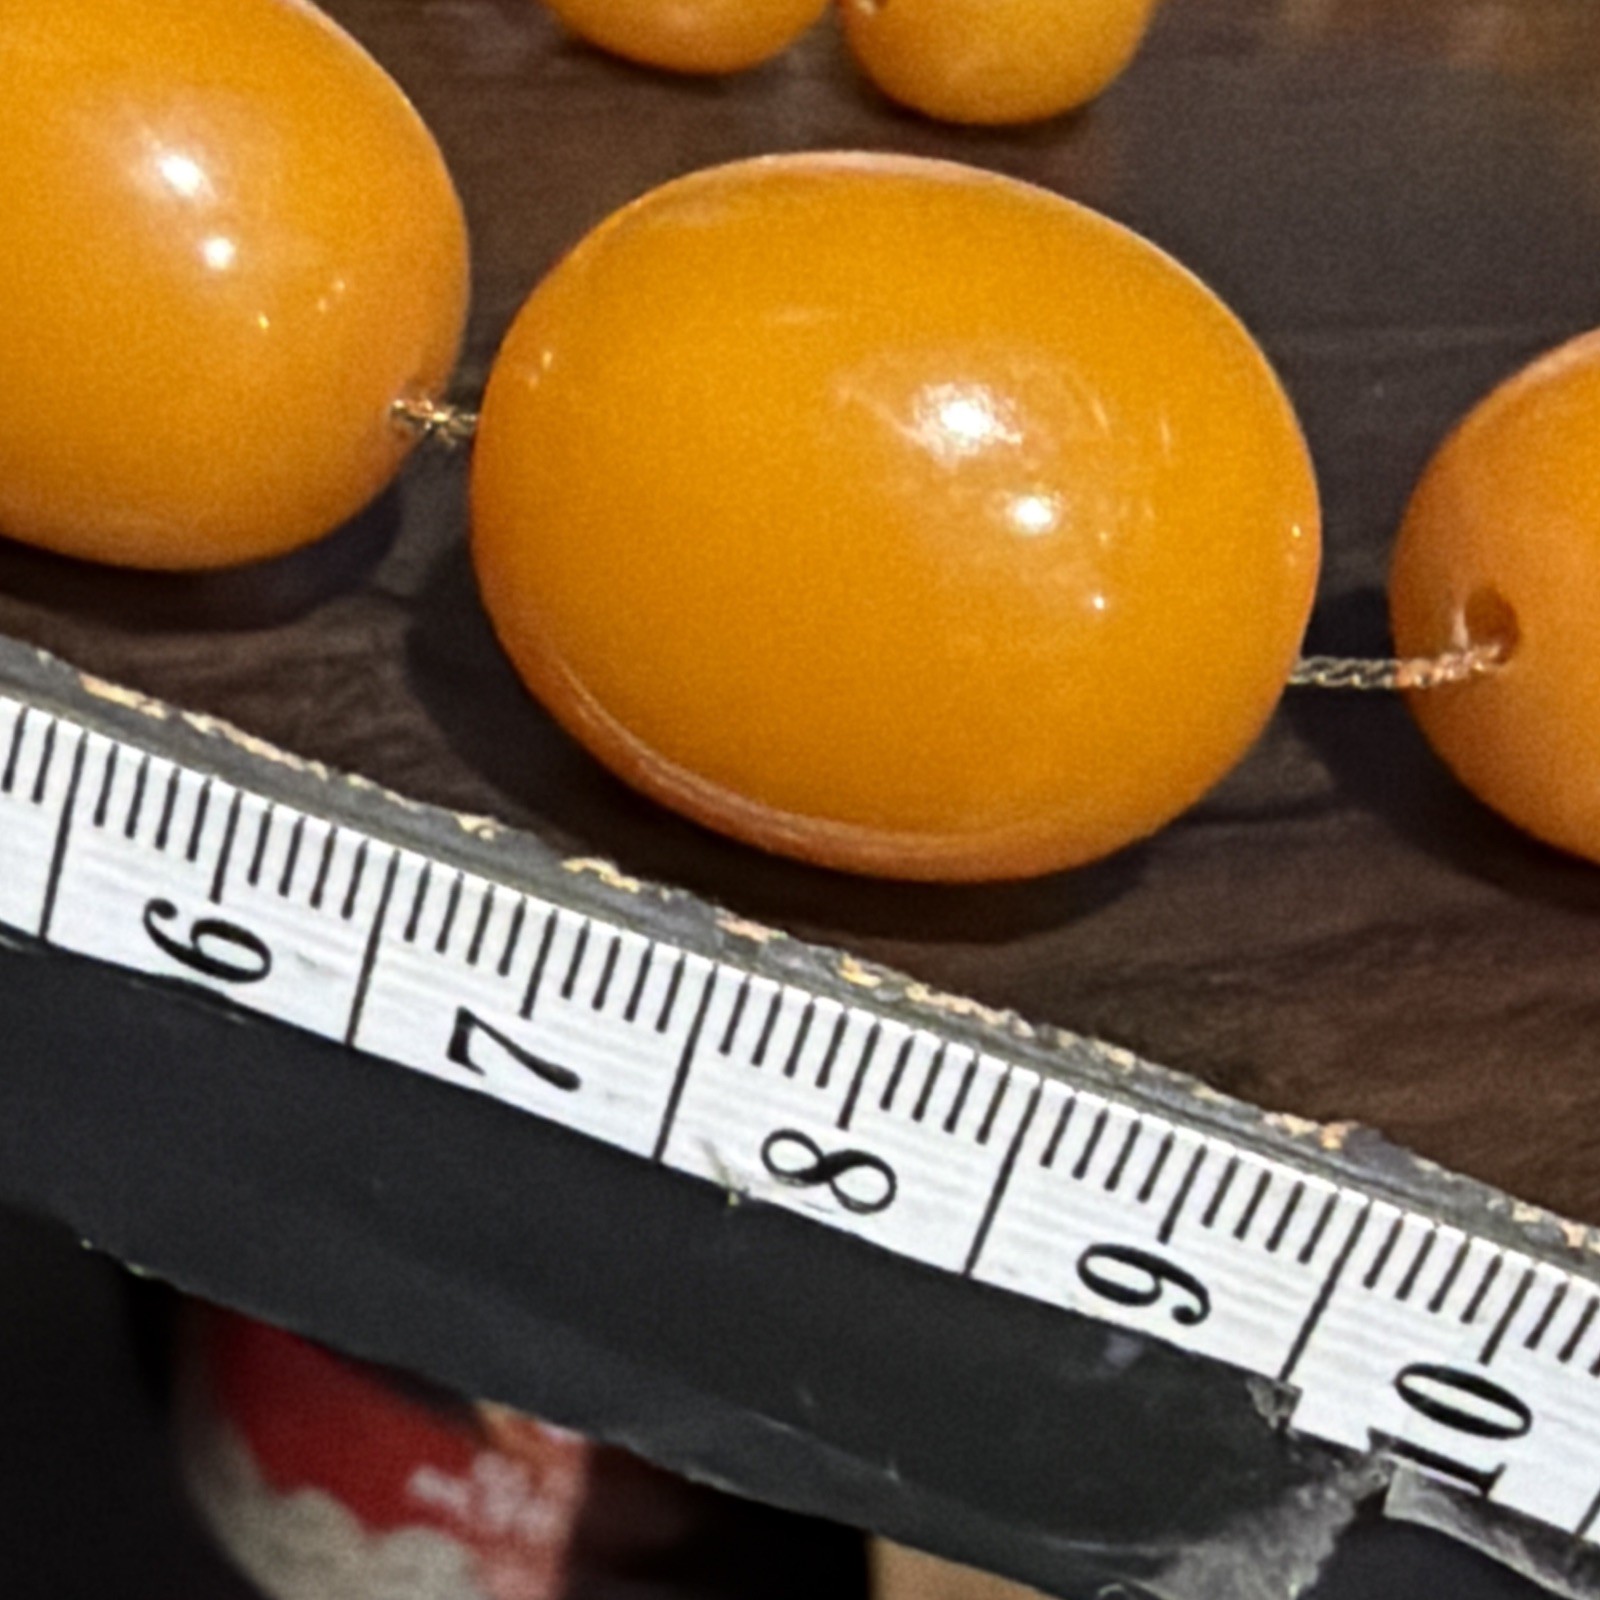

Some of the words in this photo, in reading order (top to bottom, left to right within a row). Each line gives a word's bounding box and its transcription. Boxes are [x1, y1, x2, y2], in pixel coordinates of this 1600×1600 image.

[144, 899, 272, 984] 6
[447, 1006, 582, 1092] 7
[762, 1129, 897, 1215] 8
[1077, 1244, 1211, 1326] 9
[1366, 1363, 1533, 1498] 10
